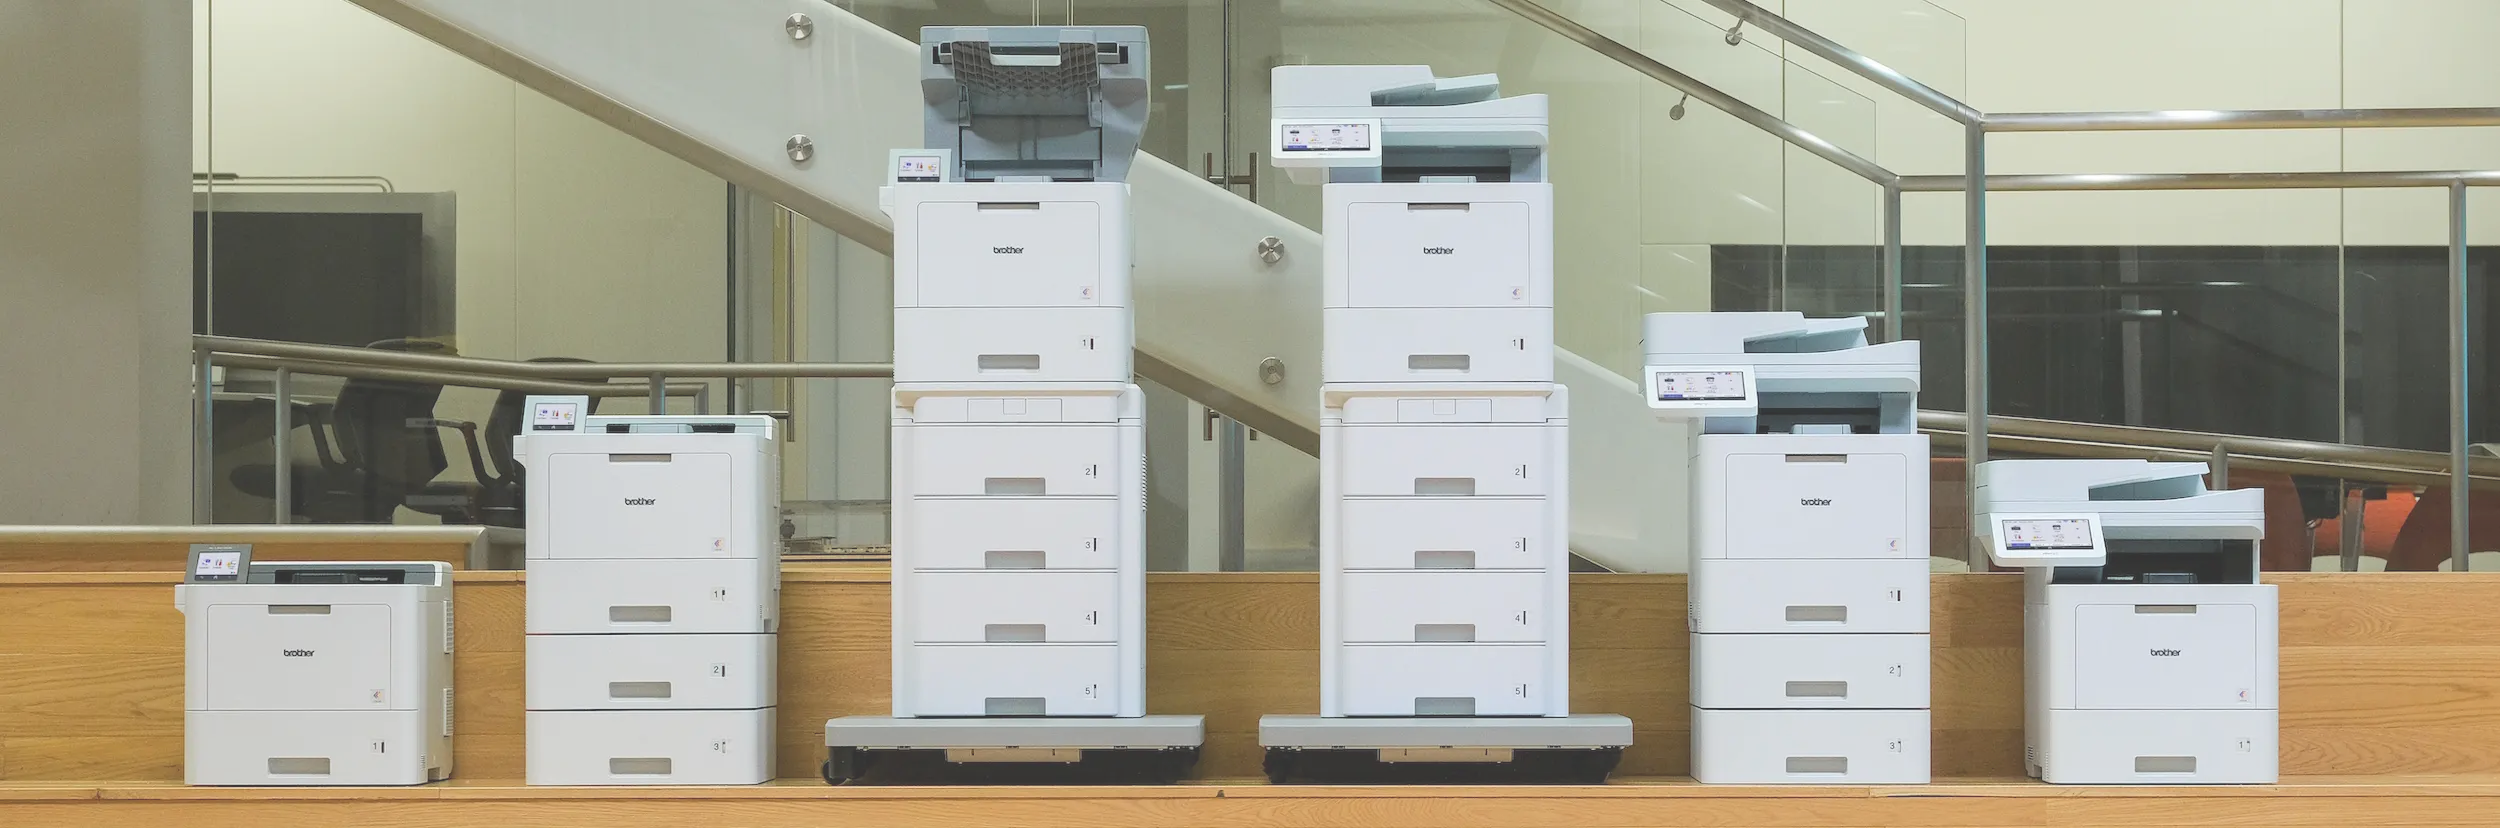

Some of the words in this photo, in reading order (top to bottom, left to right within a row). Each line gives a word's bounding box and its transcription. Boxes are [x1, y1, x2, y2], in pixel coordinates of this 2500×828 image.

[993, 246, 1025, 254] brother
[1423, 246, 1455, 255] brother
[1085, 467, 1091, 476] 2
[1514, 467, 1521, 476] 2
[624, 497, 656, 506] brother
[1800, 498, 1832, 506] brother
[1085, 541, 1091, 549] 3
[1514, 541, 1521, 549] 3
[1514, 614, 1520, 622] 4
[283, 648, 315, 657] brother
[2150, 648, 2182, 657] brother
[713, 665, 719, 674] 2
[1889, 666, 1895, 674] 2
[1085, 686, 1091, 695] 5
[1515, 687, 1521, 695] 5
[713, 742, 720, 751] 3
[1889, 741, 1895, 750] 3
